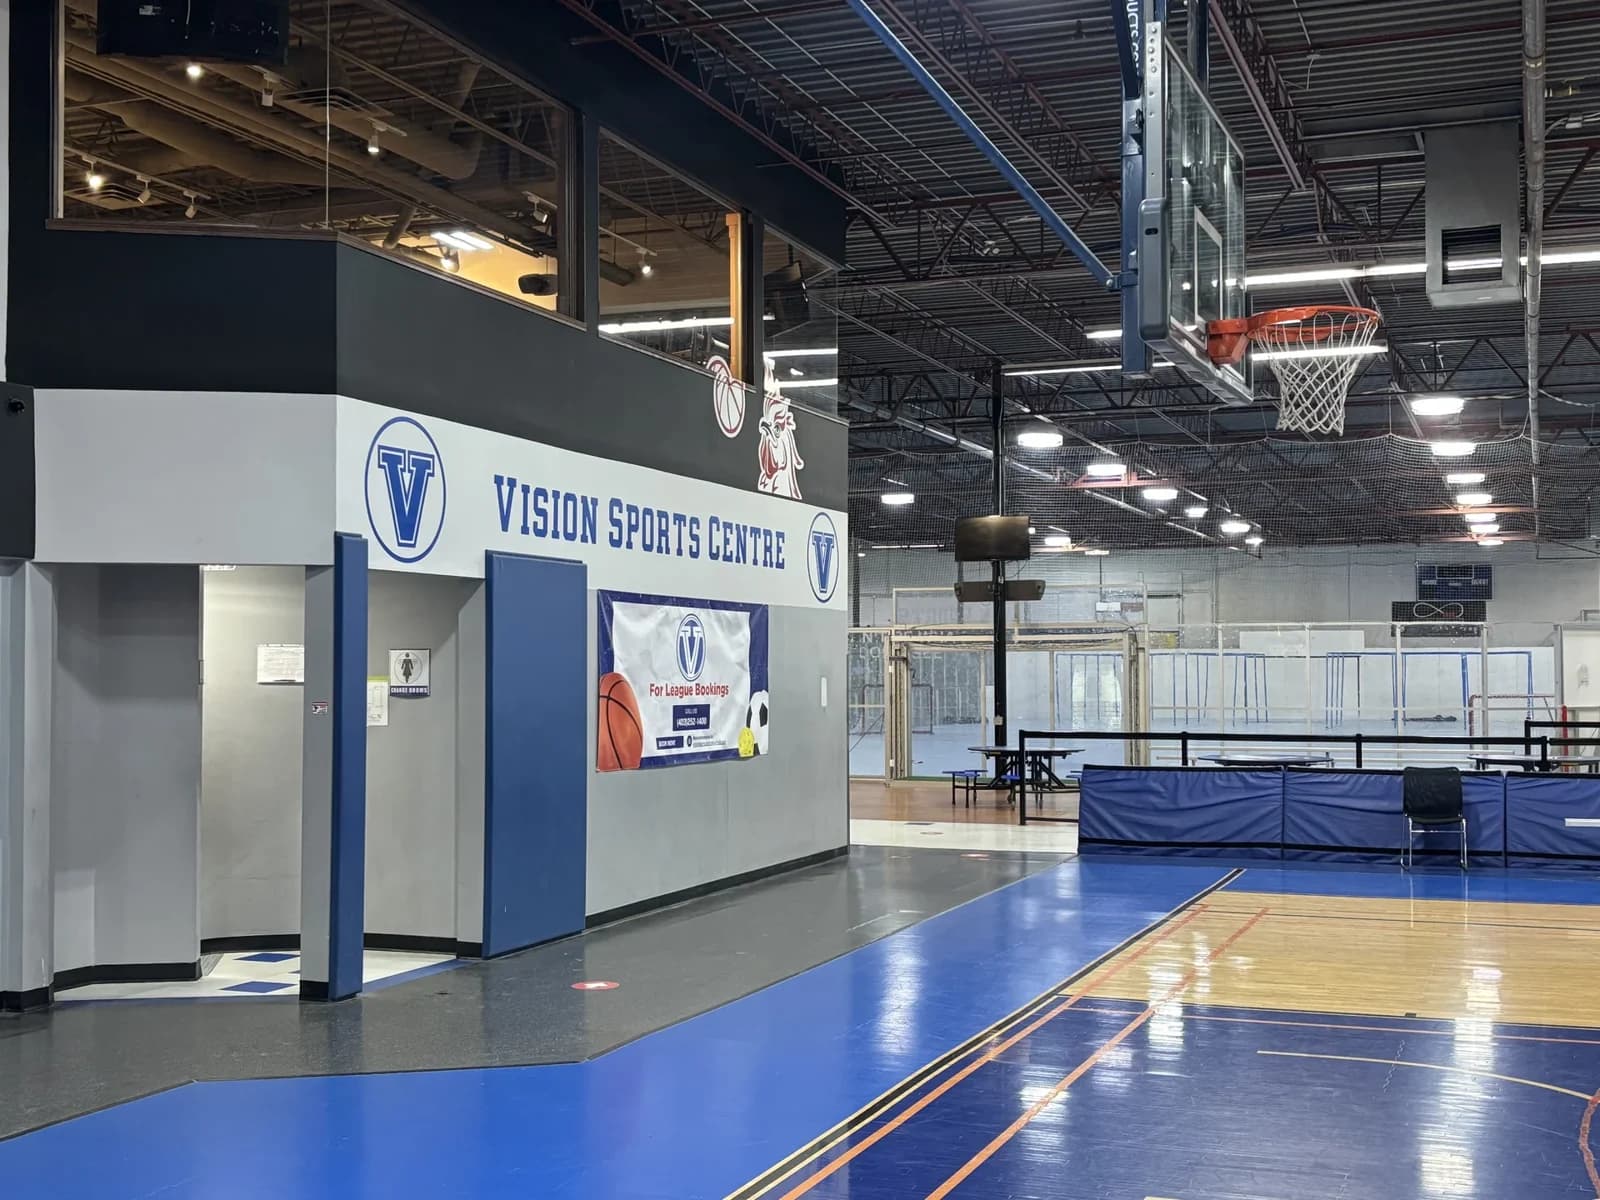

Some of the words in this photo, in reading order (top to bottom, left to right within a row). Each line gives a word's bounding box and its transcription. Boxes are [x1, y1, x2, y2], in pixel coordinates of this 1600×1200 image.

[377, 444, 436, 548] V
[493, 474, 599, 545] VISION
[608, 497, 701, 560] SPORTS
[708, 514, 786, 570] CENTRE
[812, 530, 835, 594] V
[649, 684, 663, 697] For
[665, 683, 693, 698] League
[695, 682, 729, 698] Bookings
